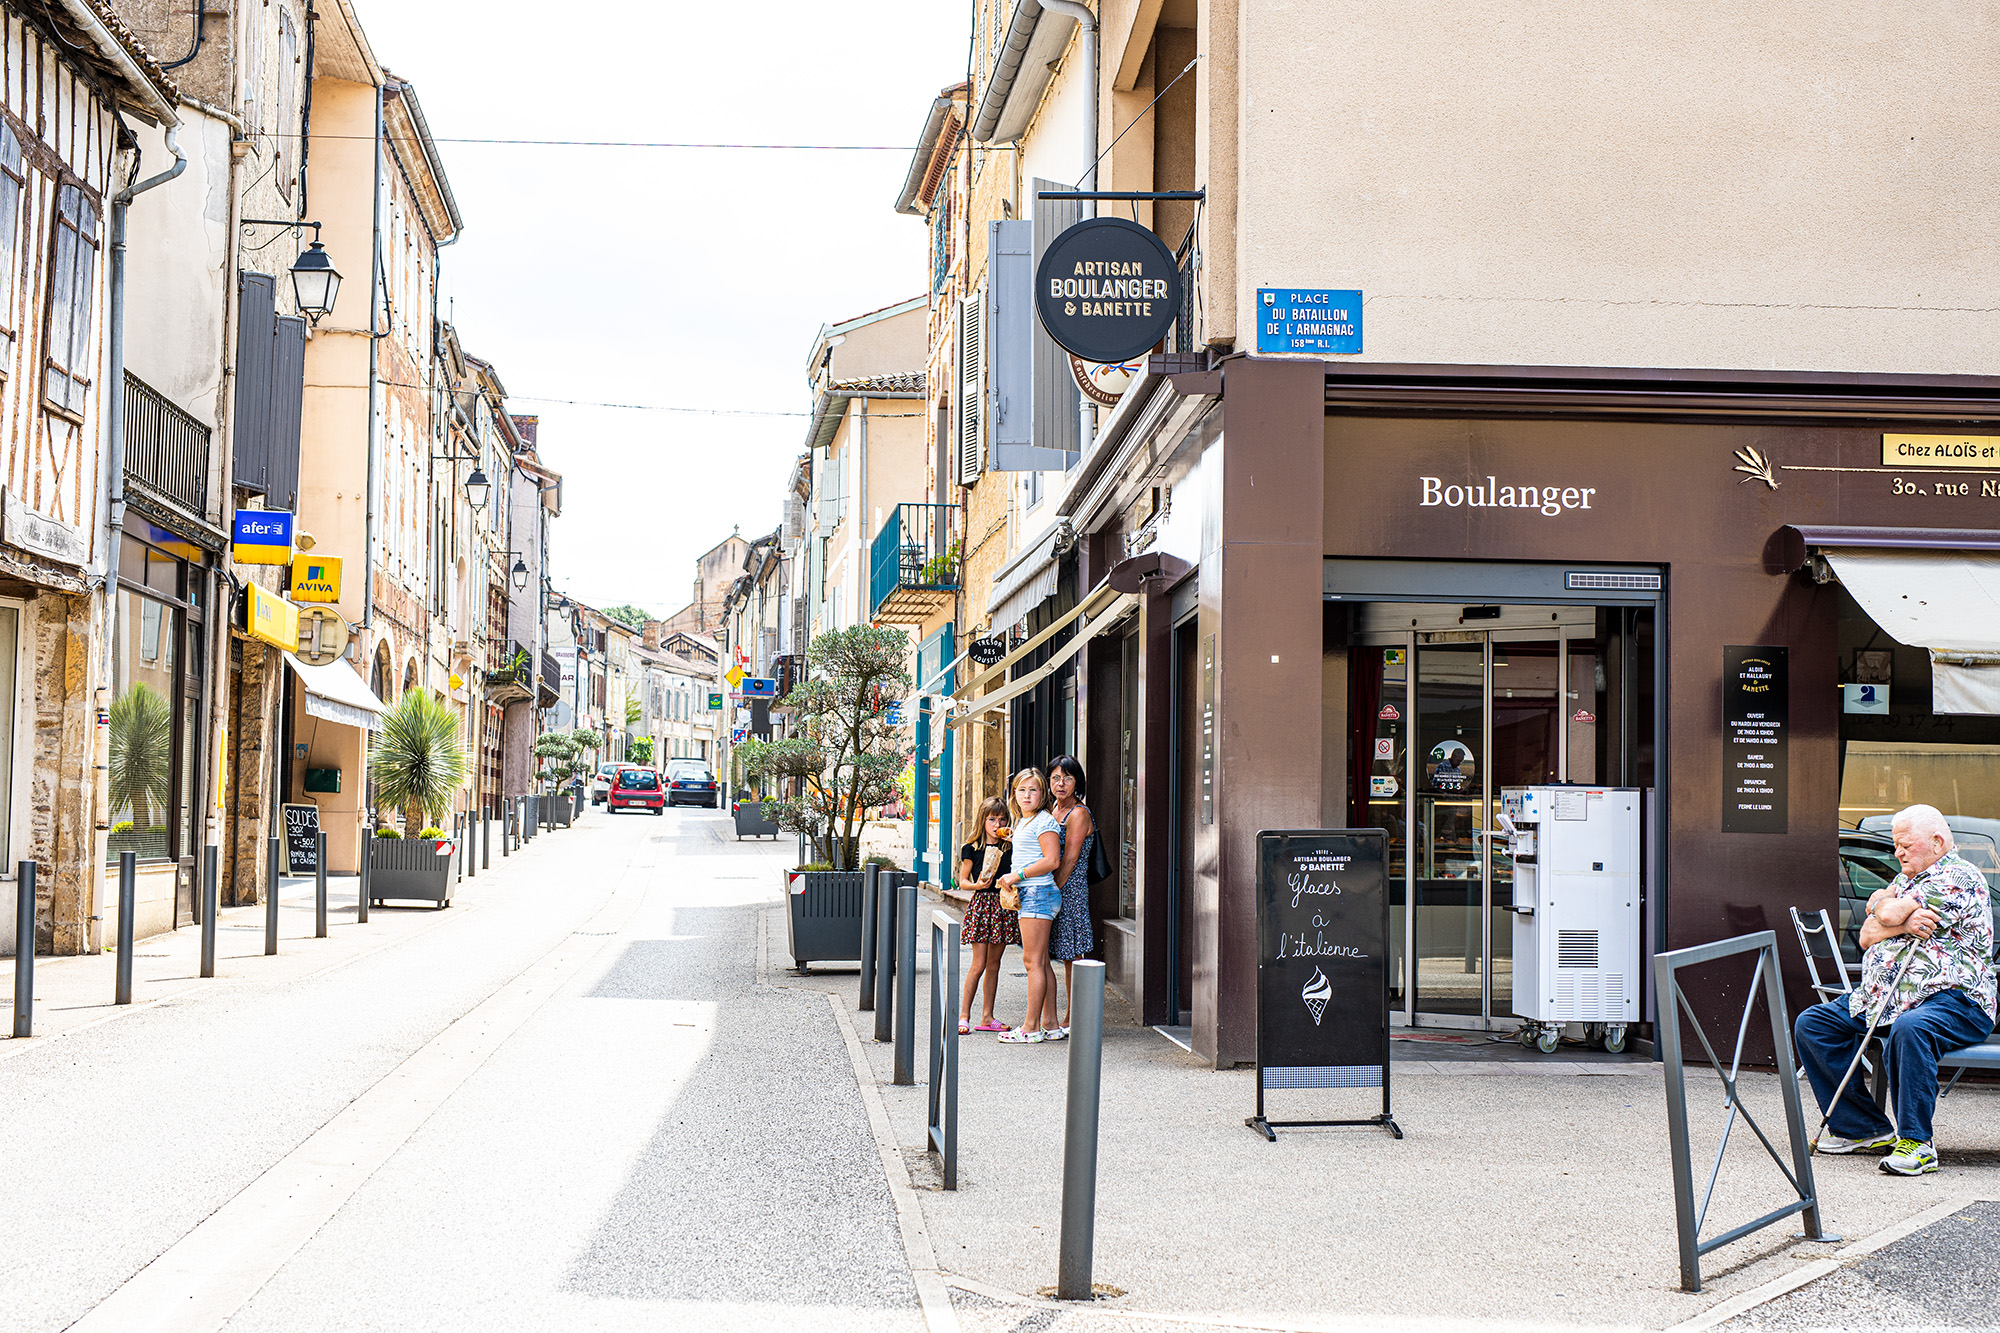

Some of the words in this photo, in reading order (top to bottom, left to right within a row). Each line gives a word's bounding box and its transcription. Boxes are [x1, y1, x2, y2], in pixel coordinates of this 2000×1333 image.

[1074, 262, 1142, 276] ARTISAN
[1051, 278, 1168, 299] BOULANGER
[1291, 294, 1328, 303] PLACE
[1065, 302, 1076, 316] &
[1082, 302, 1152, 316] BANETTE
[1273, 308, 1285, 320] DU
[1292, 309, 1347, 320] BATAILLON
[1267, 323, 1279, 334] DE
[1318, 340, 1330, 348] R.I.
[1898, 444, 1930, 456] Chez
[1935, 442, 1977, 457] ALOÏS
[1982, 447, 1994, 457] et
[1935, 482, 1968, 496] rue
[1981, 480, 2000, 497] N
[1420, 476, 1596, 516] Boulanger
[242, 522, 270, 534] afer
[297, 583, 333, 592] AVIVA
[1742, 684, 1769, 692] BANETTE
[286, 810, 319, 828] SOLDES
[299, 838, 314, 846] -50%
[1288, 873, 1341, 908] Glaces
[1312, 909, 1330, 928] à
[1276, 931, 1368, 959] l'italienne
